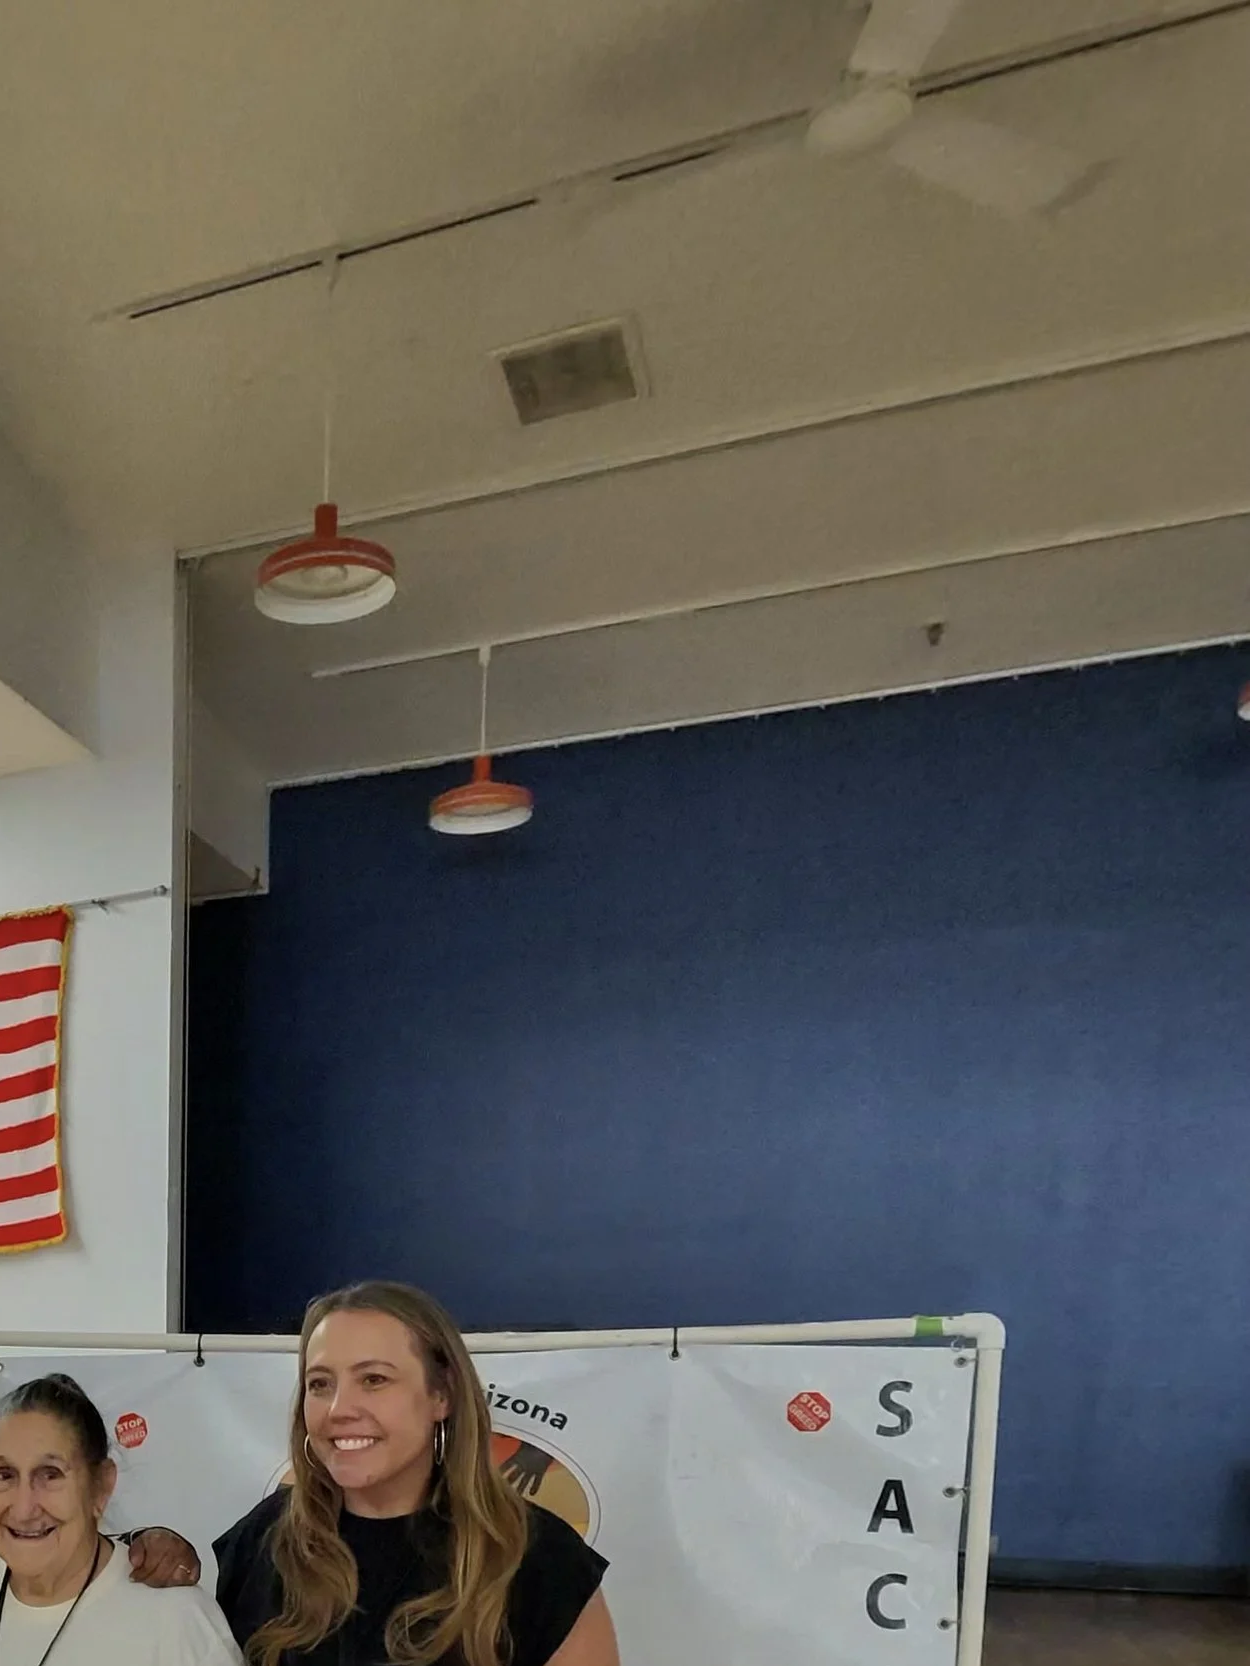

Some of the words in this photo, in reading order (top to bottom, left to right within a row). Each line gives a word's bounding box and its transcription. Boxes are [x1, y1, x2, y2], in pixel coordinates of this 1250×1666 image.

[486, 1383, 568, 1430] izona
[800, 1393, 829, 1419] STOP
[116, 1418, 143, 1433] STOP
